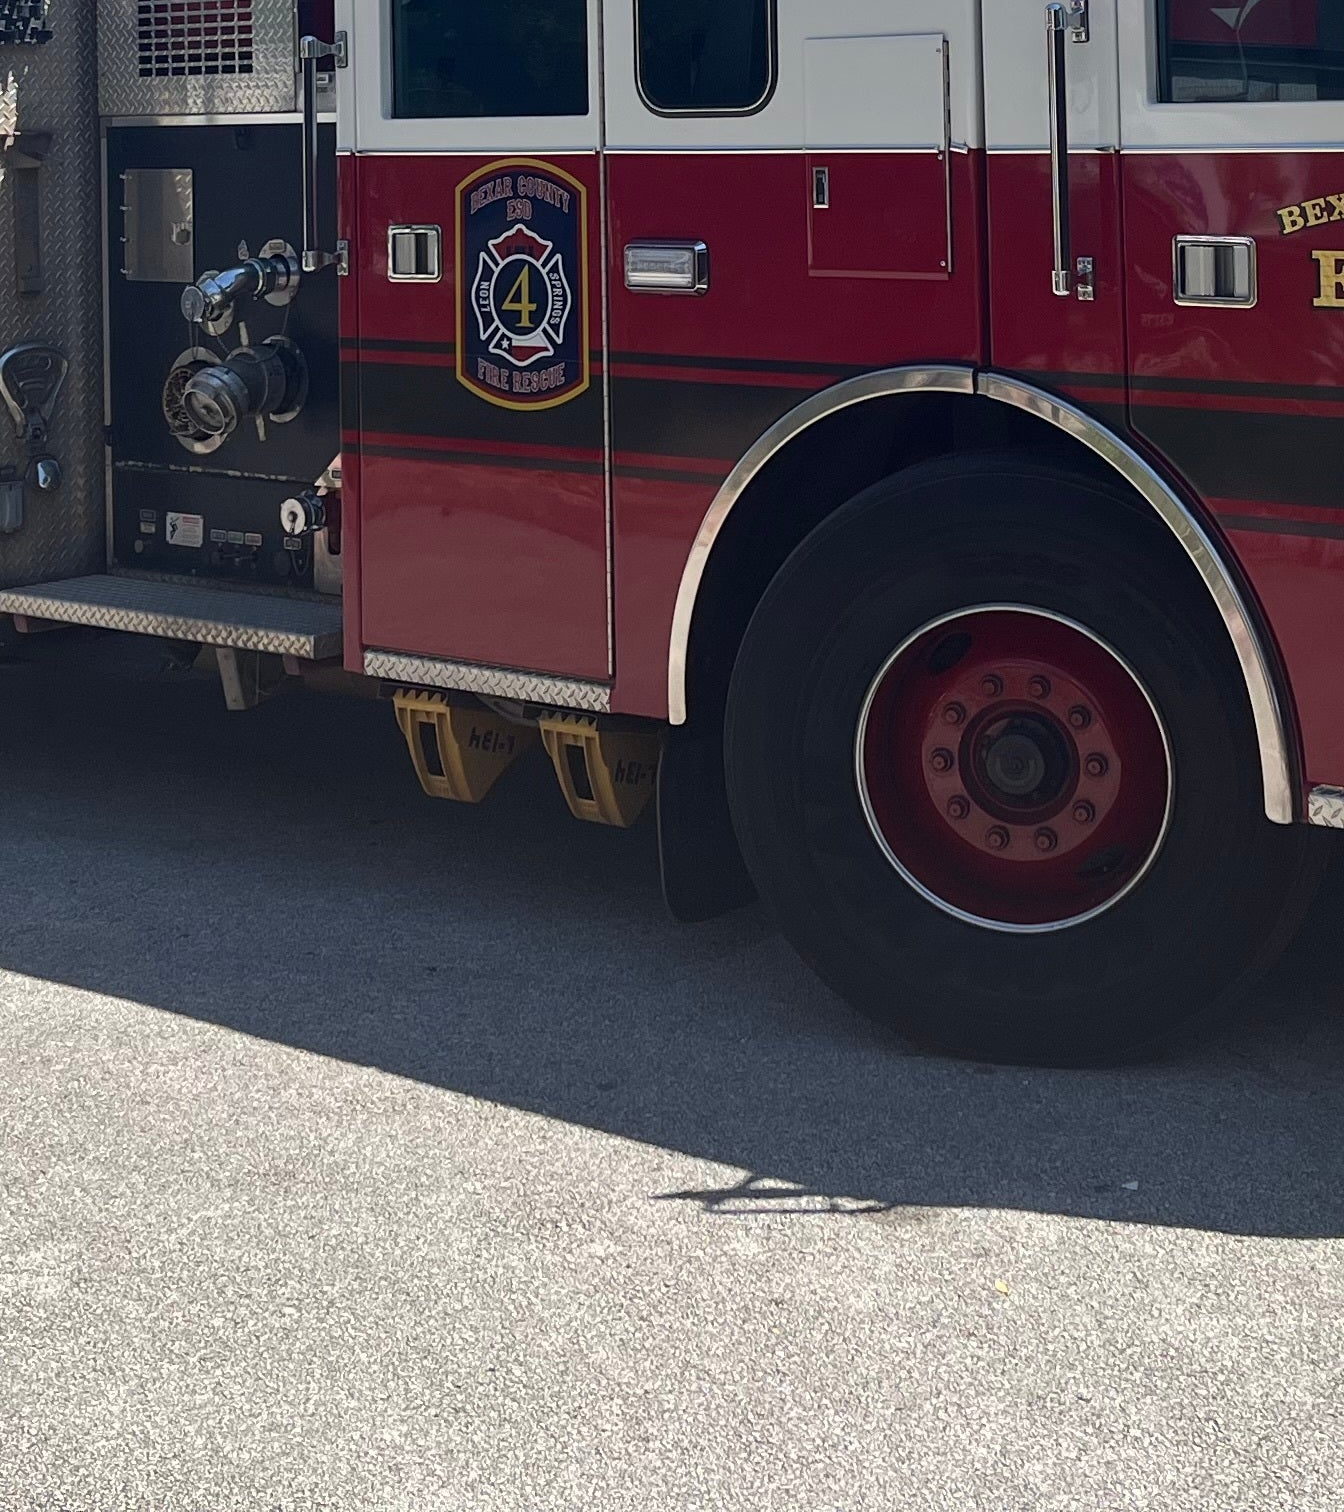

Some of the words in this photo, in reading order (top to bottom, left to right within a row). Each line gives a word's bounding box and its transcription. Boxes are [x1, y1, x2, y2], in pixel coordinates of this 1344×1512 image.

[470, 176, 514, 216] BEXAR
[517, 175, 570, 215] COUNTY
[506, 199, 532, 221] ESD
[479, 281, 491, 312] LEON
[501, 263, 537, 328] 4
[549, 272, 564, 325] SPRINGS
[477, 357, 509, 391] FIRE
[512, 362, 566, 393] RESCUE
